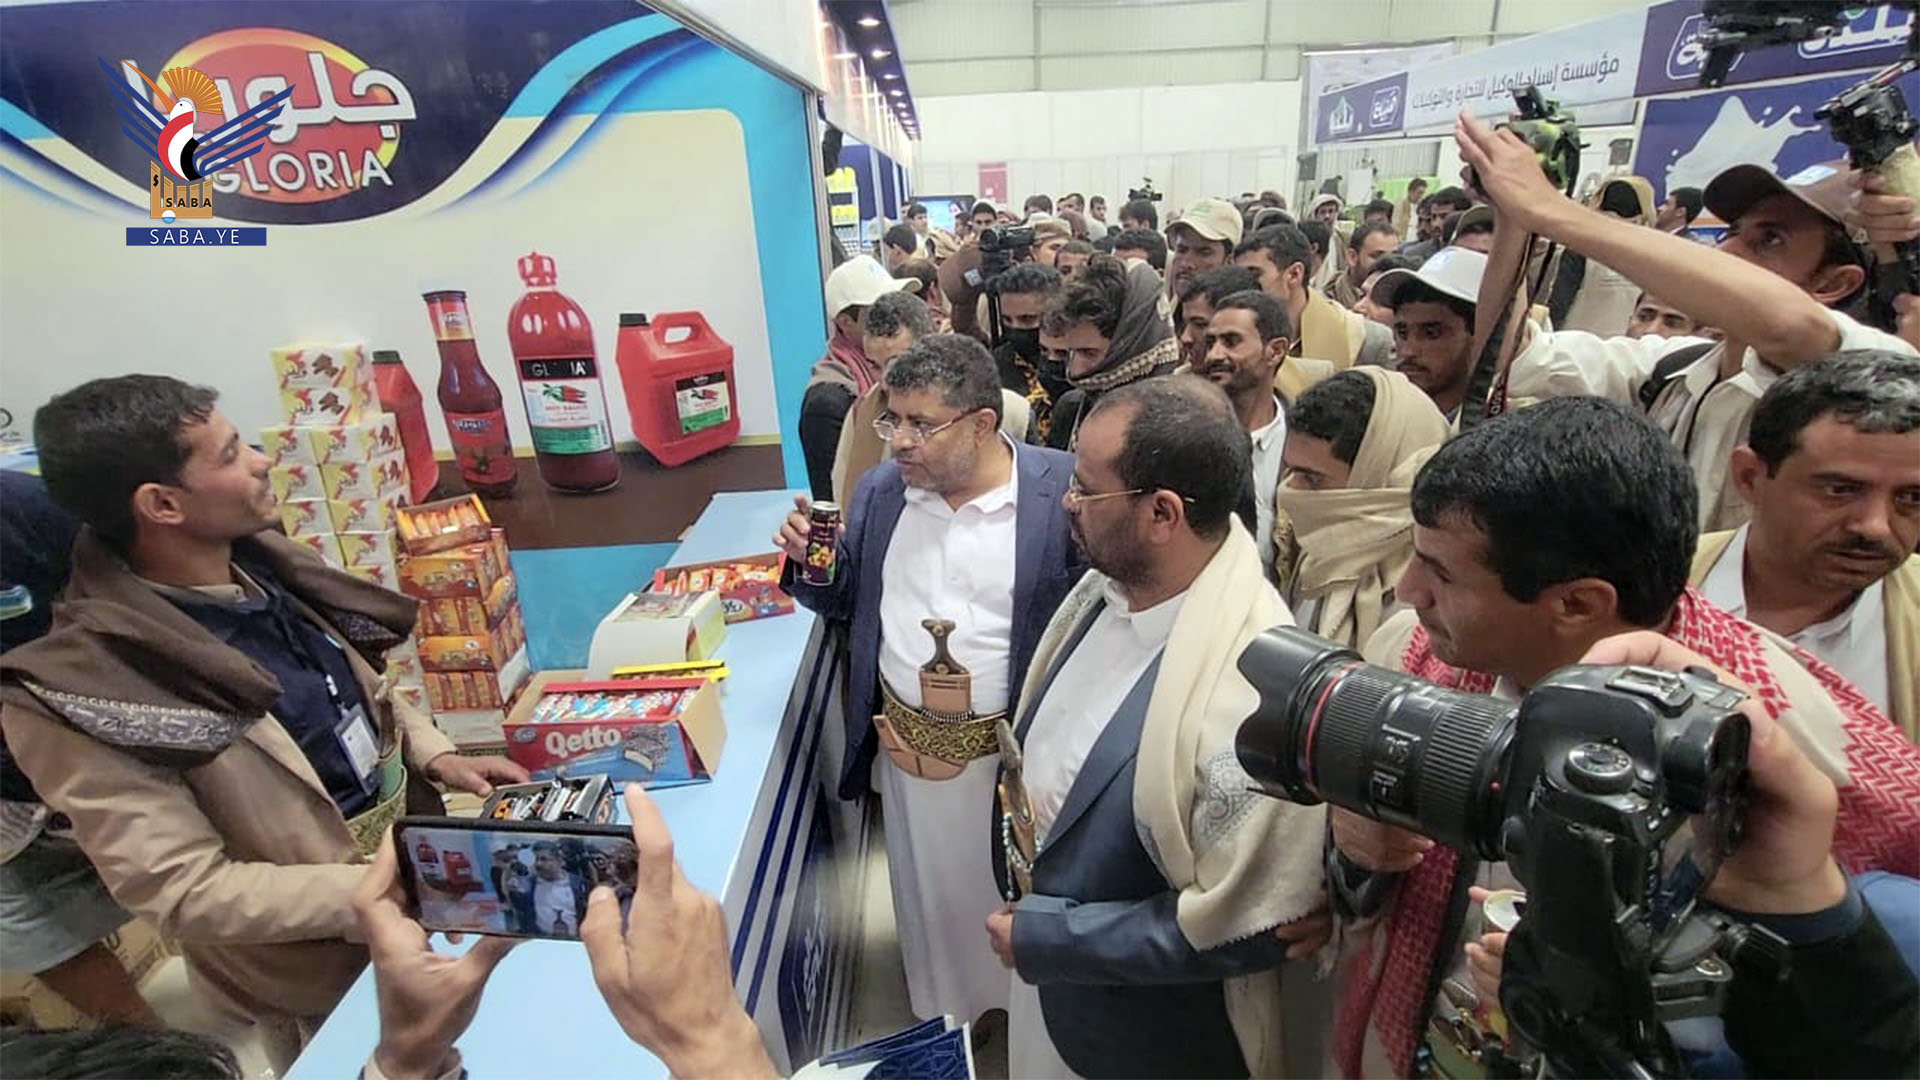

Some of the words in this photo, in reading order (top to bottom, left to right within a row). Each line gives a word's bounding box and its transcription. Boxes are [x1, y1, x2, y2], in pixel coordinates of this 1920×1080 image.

[1561, 51, 1619, 84] مؤسسة
[121, 51, 416, 145] جلورا
[207, 150, 394, 193] GLORIA
[531, 361, 586, 377] GLIA
[545, 725, 621, 758] Qetto
